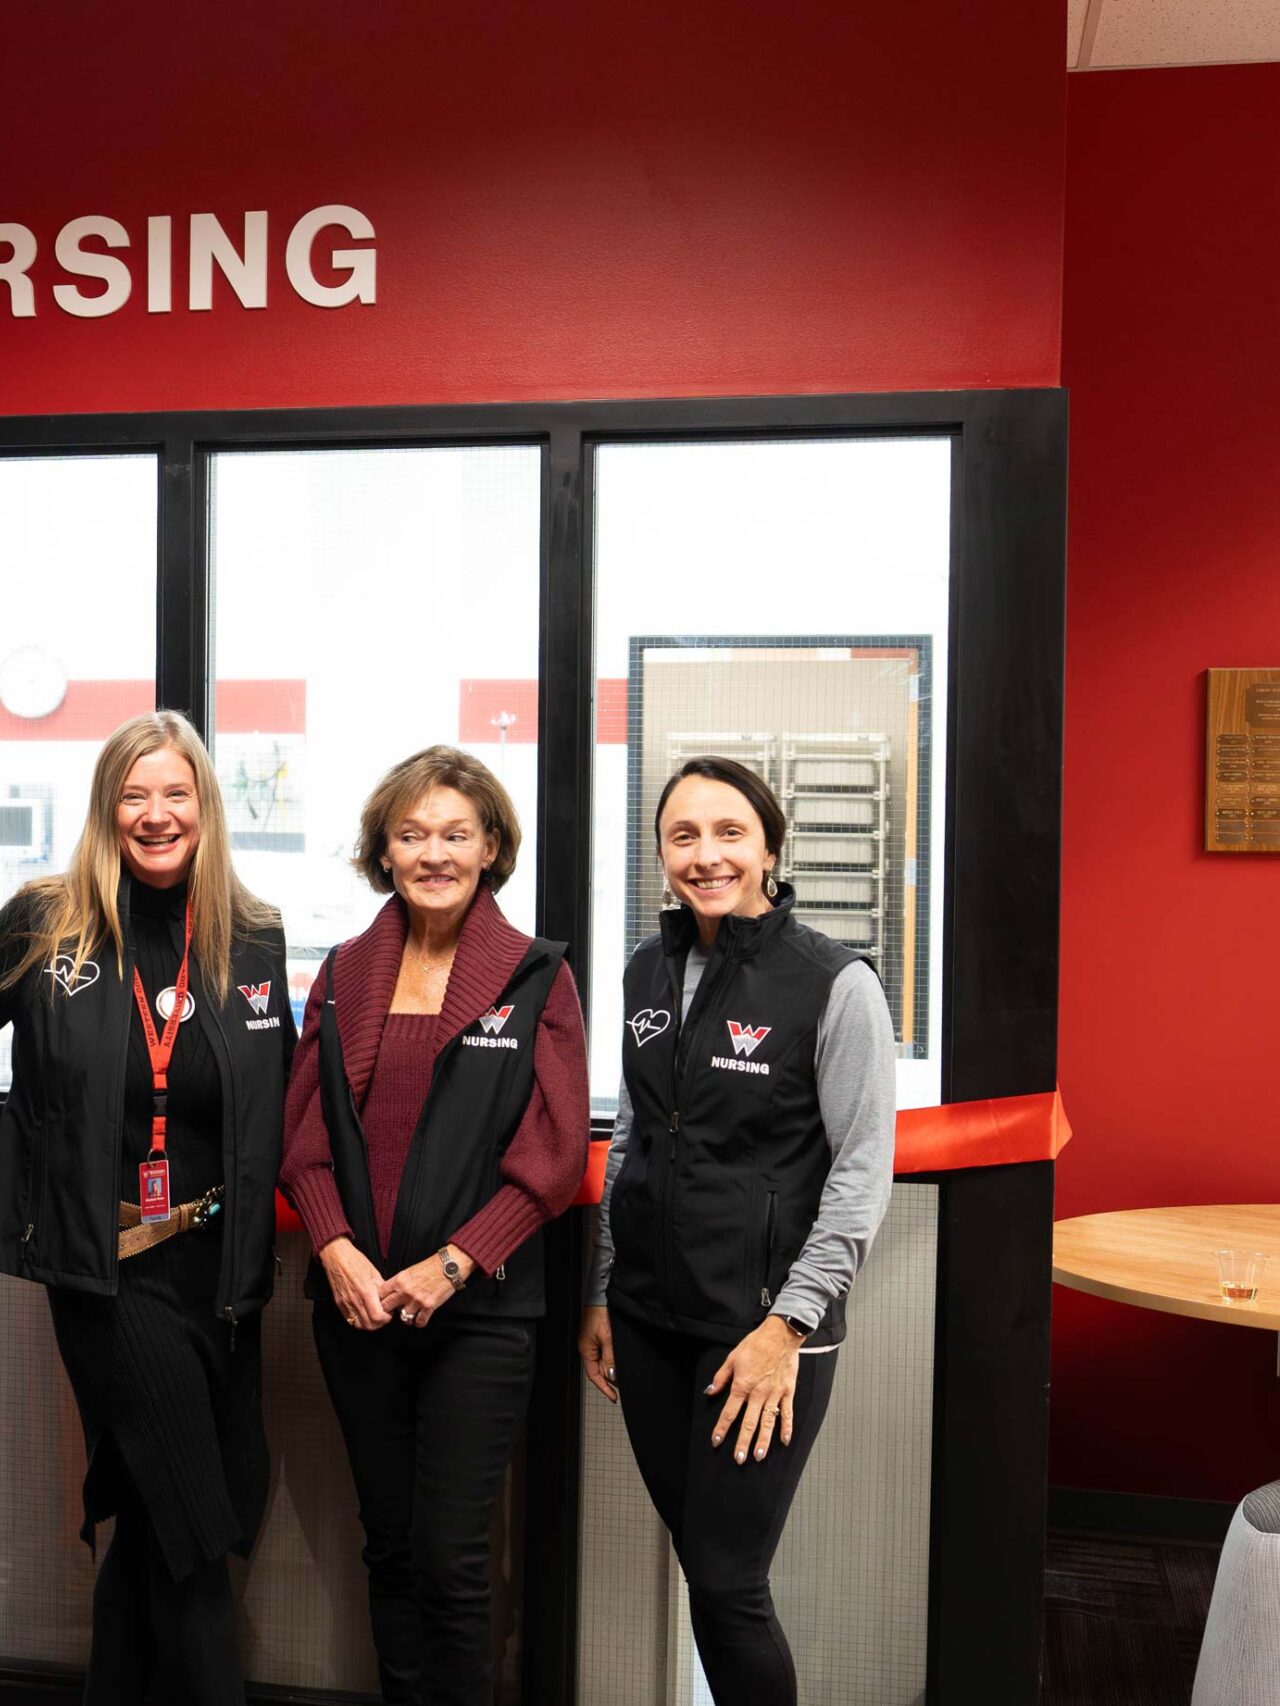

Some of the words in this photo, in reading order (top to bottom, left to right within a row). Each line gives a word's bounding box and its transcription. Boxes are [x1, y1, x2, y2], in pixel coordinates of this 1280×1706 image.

[245, 1016, 280, 1031] NURSIN
[462, 1035, 518, 1049] NURSING
[711, 1056, 770, 1075] NURSING
